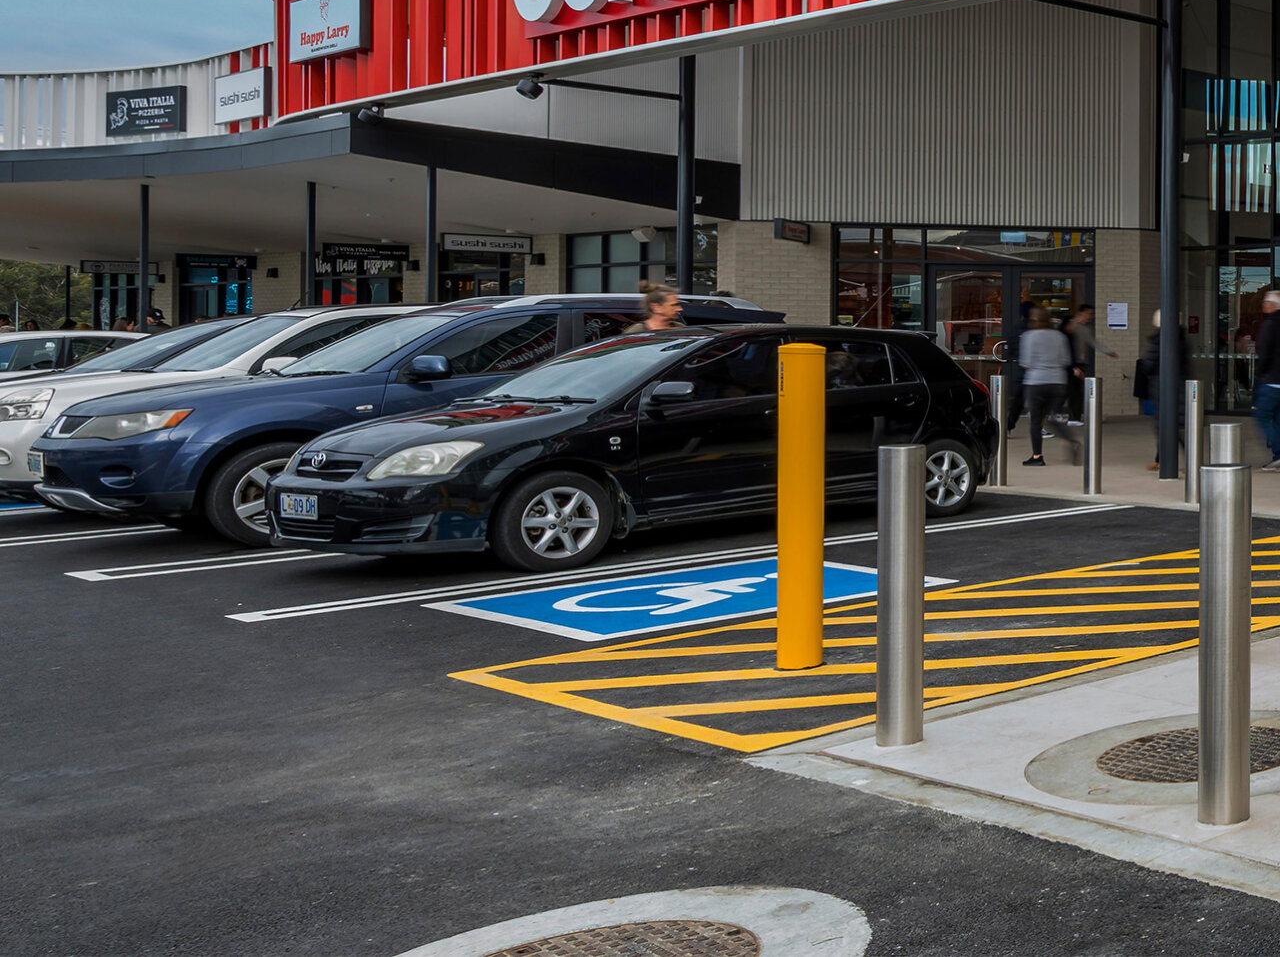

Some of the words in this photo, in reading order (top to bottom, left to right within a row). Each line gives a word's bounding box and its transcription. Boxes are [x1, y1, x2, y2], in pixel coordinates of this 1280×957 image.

[300, 31, 325, 47] Happy
[327, 25, 350, 40] Larry
[130, 98, 148, 109] VIVA
[149, 95, 175, 107] ITALIA
[219, 91, 240, 107] sushi
[241, 86, 261, 103] sushi
[138, 108, 165, 116] PIZZERIA
[451, 239, 487, 247] sushi
[489, 241, 524, 249] sushi
